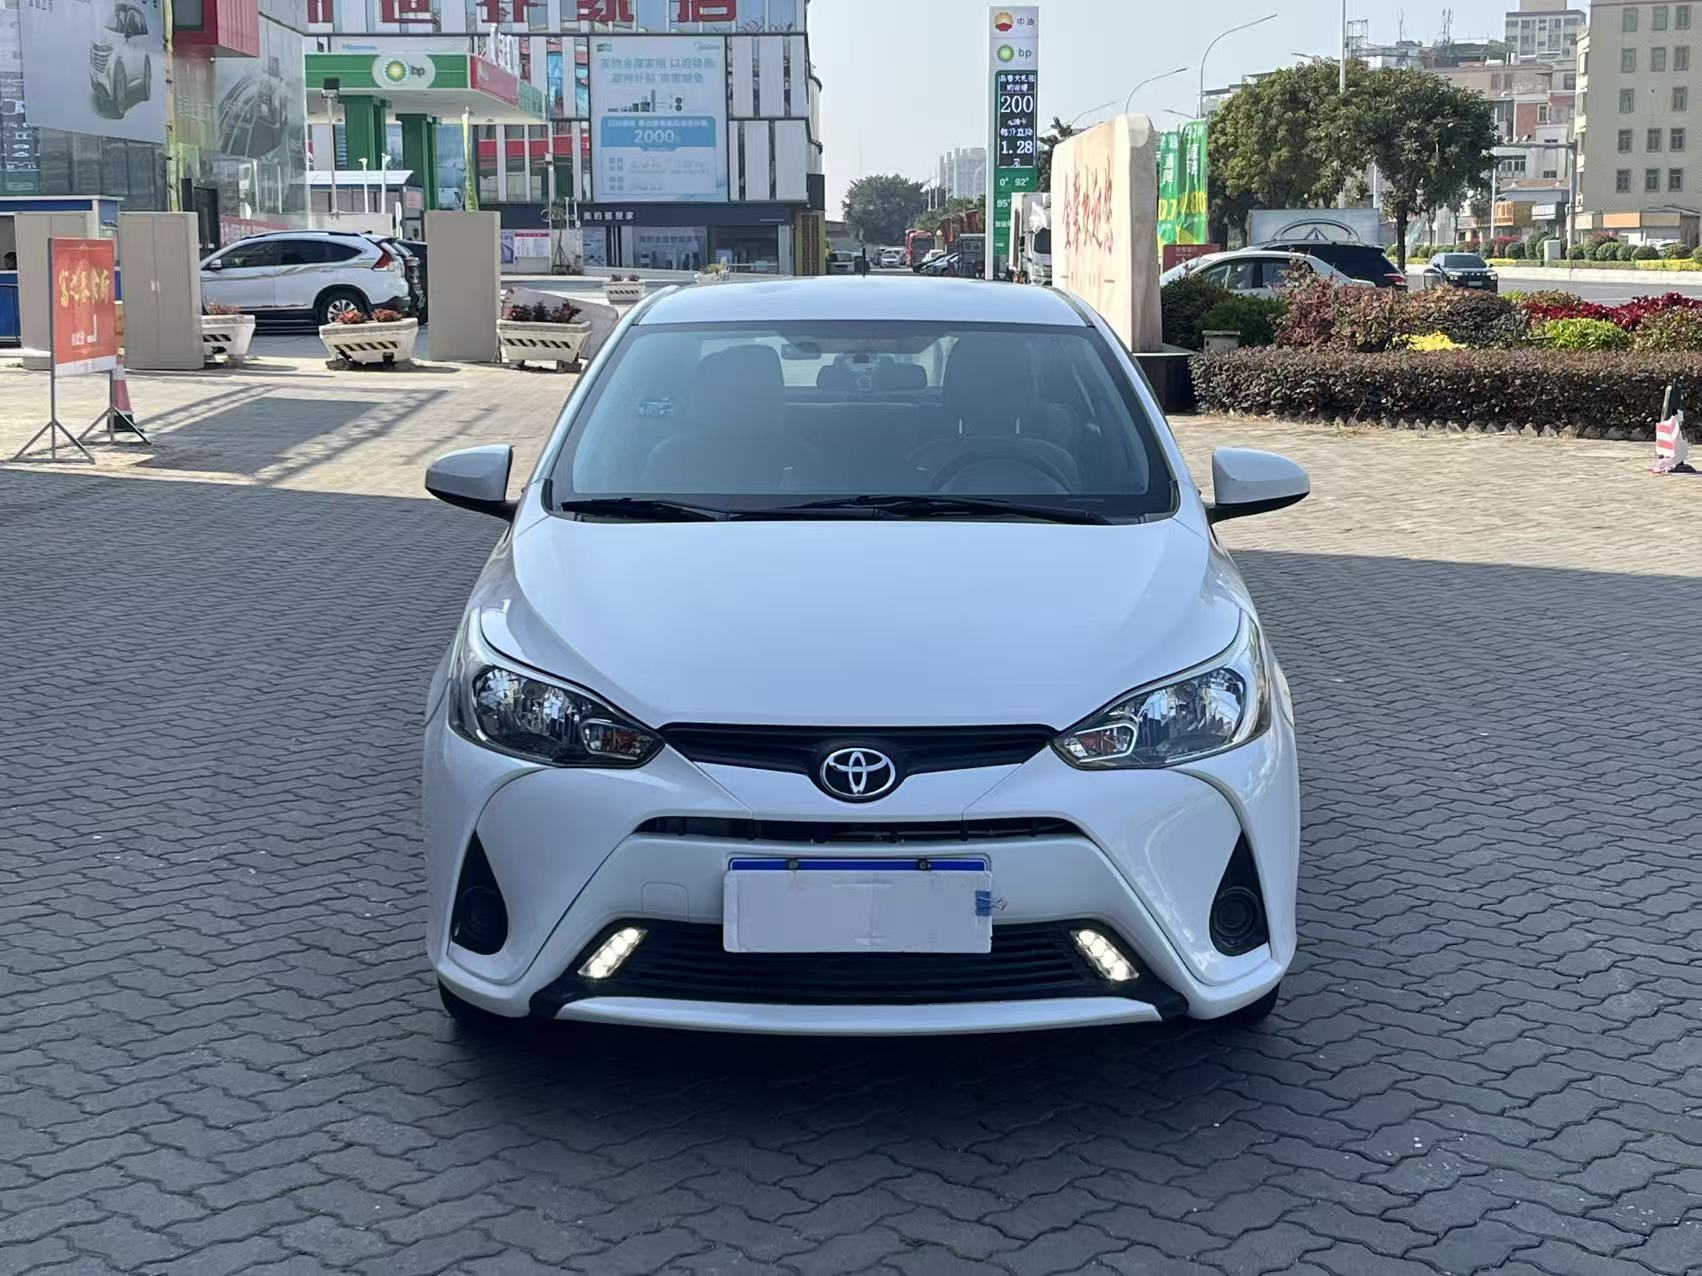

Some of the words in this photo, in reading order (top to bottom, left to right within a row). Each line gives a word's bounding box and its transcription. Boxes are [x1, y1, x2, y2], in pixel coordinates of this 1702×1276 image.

[1018, 48, 1032, 59] bp
[410, 65, 426, 78] bp
[1000, 95, 1034, 113] 200
